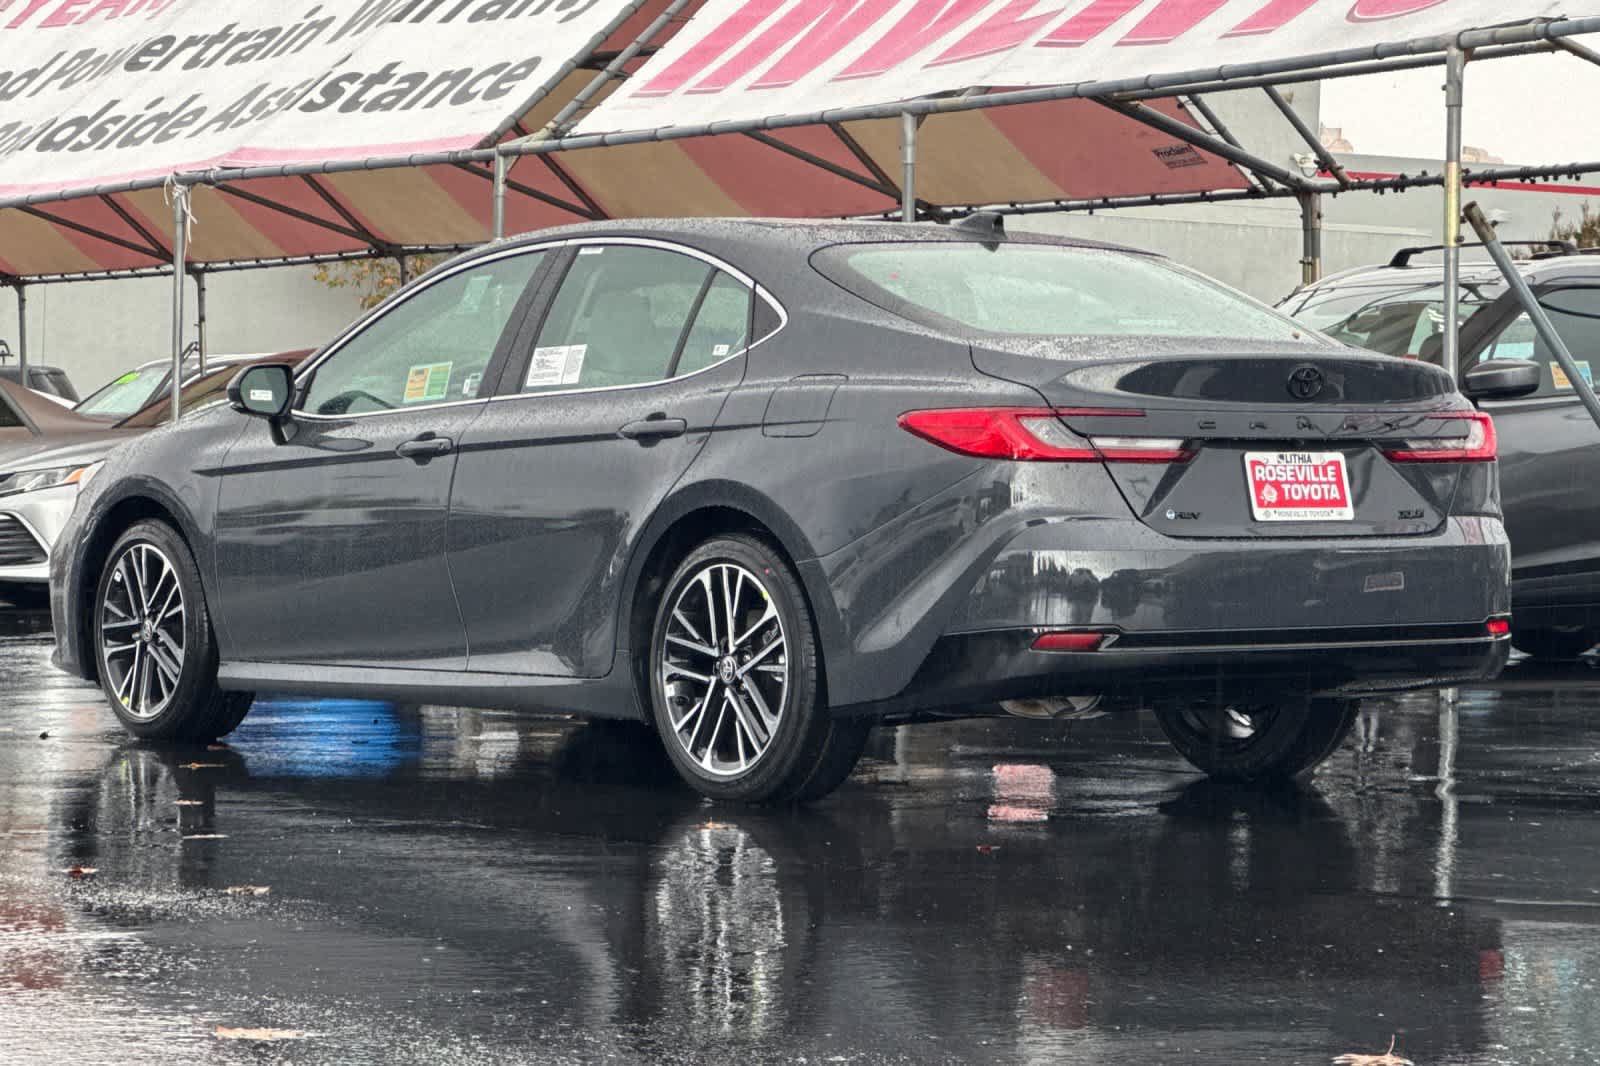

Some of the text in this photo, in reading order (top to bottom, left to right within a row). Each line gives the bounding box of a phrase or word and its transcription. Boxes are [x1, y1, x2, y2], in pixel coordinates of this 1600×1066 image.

[26, 4, 337, 98] Powertrain
[184, 53, 542, 139] Assistance
[1285, 453, 1312, 464] LITHIA
[1254, 465, 1337, 482] ROSEVILLE
[1281, 483, 1341, 501] TOYOTA
